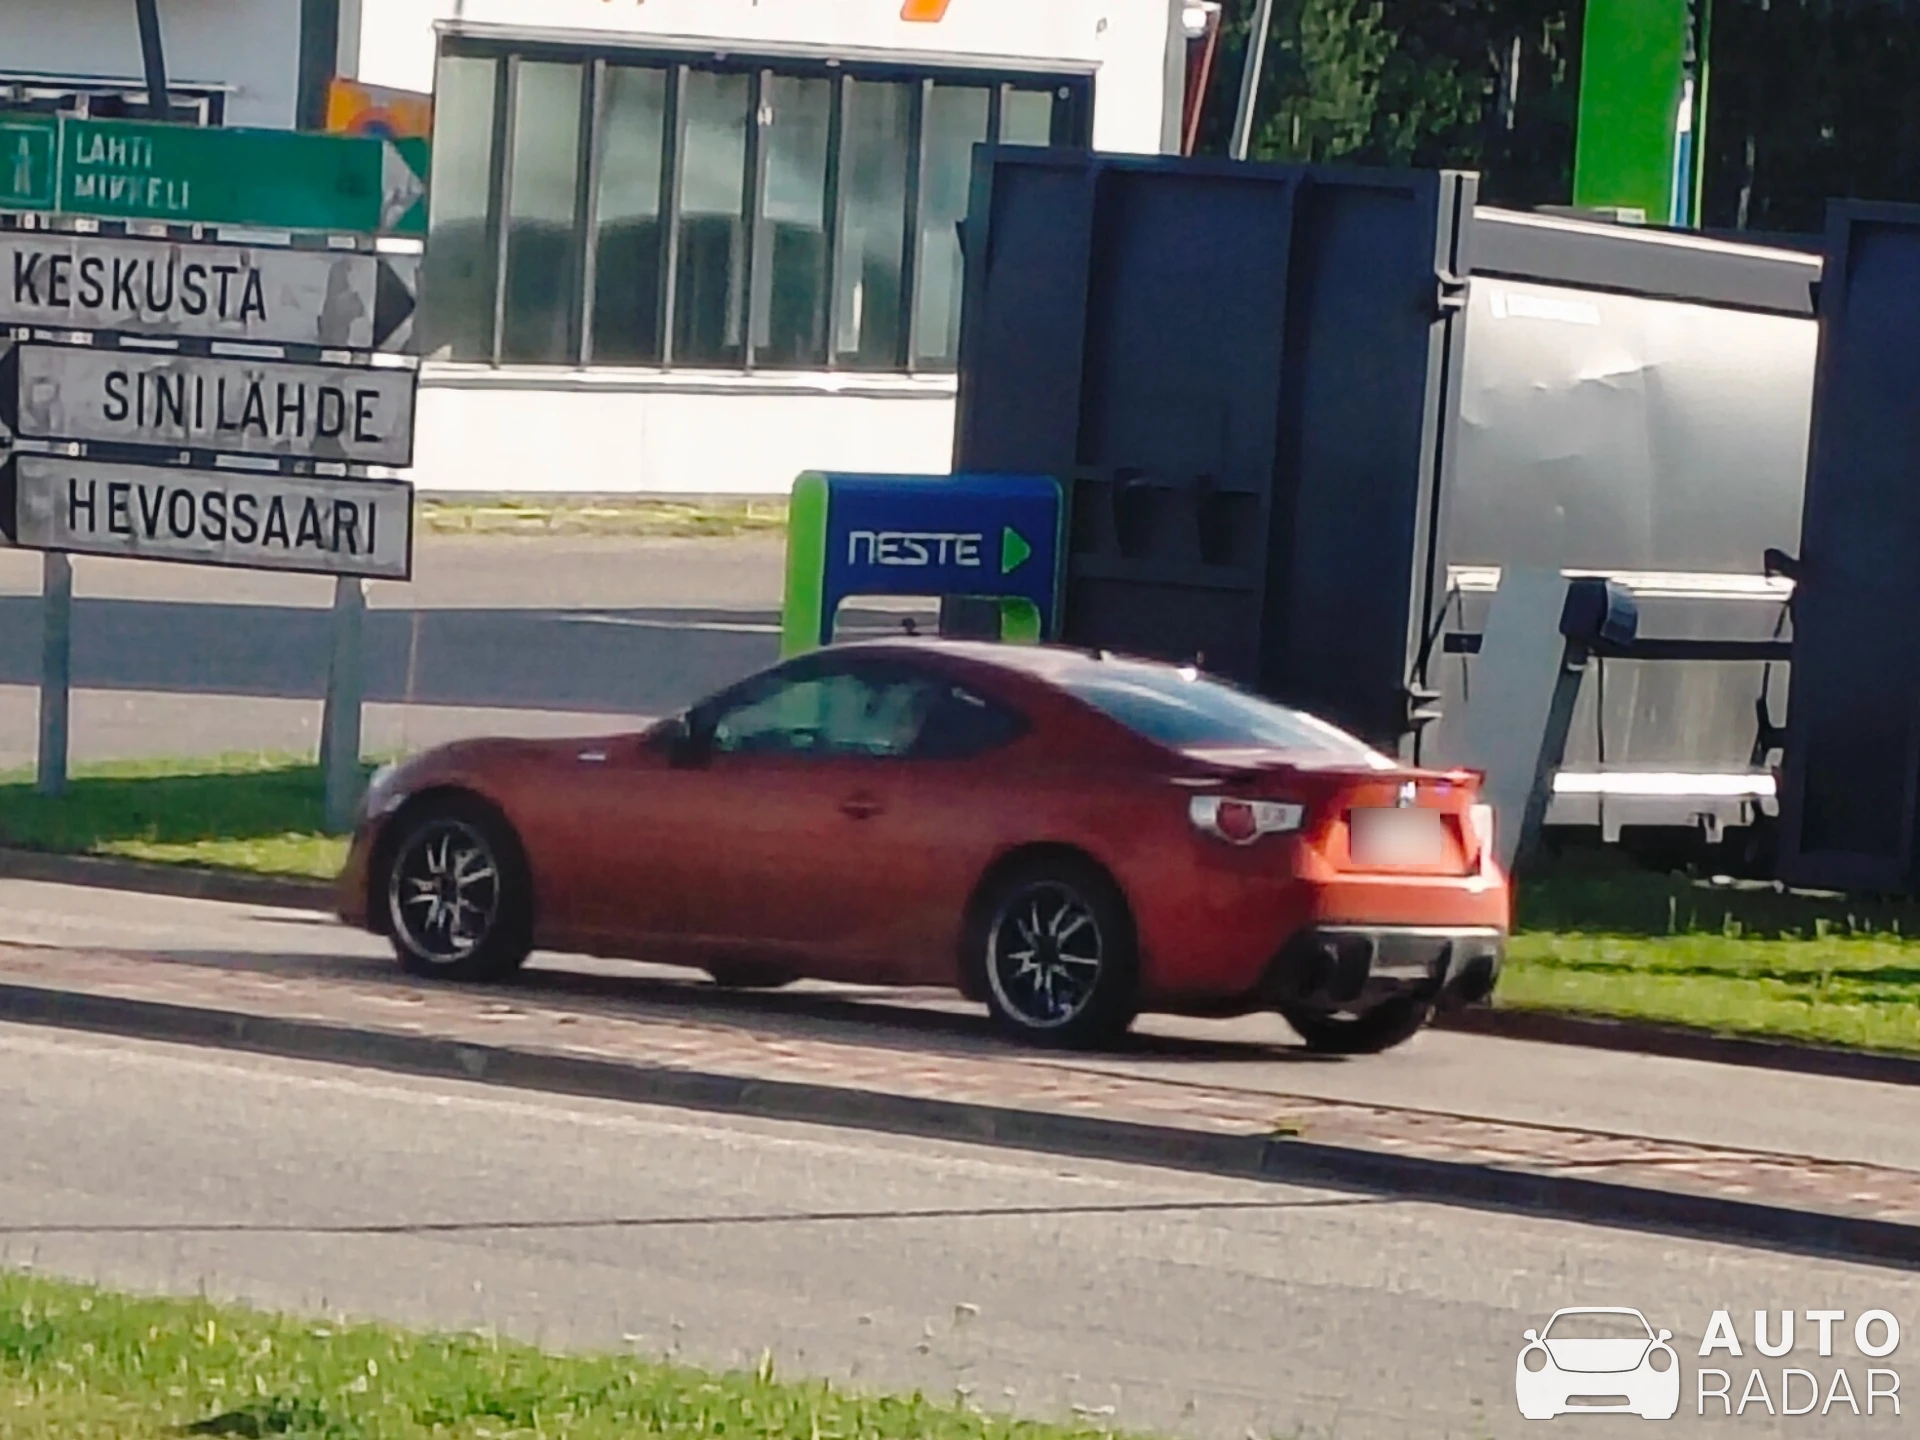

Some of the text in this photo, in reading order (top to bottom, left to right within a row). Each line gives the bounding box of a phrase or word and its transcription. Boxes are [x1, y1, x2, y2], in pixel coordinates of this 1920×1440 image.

[76, 131, 152, 168] LAHTI
[13, 250, 266, 321] KESKUSTA
[103, 370, 382, 443] SINILÄHDE
[68, 478, 377, 555] HEVOSSAARI
[848, 530, 982, 566] NESTE
